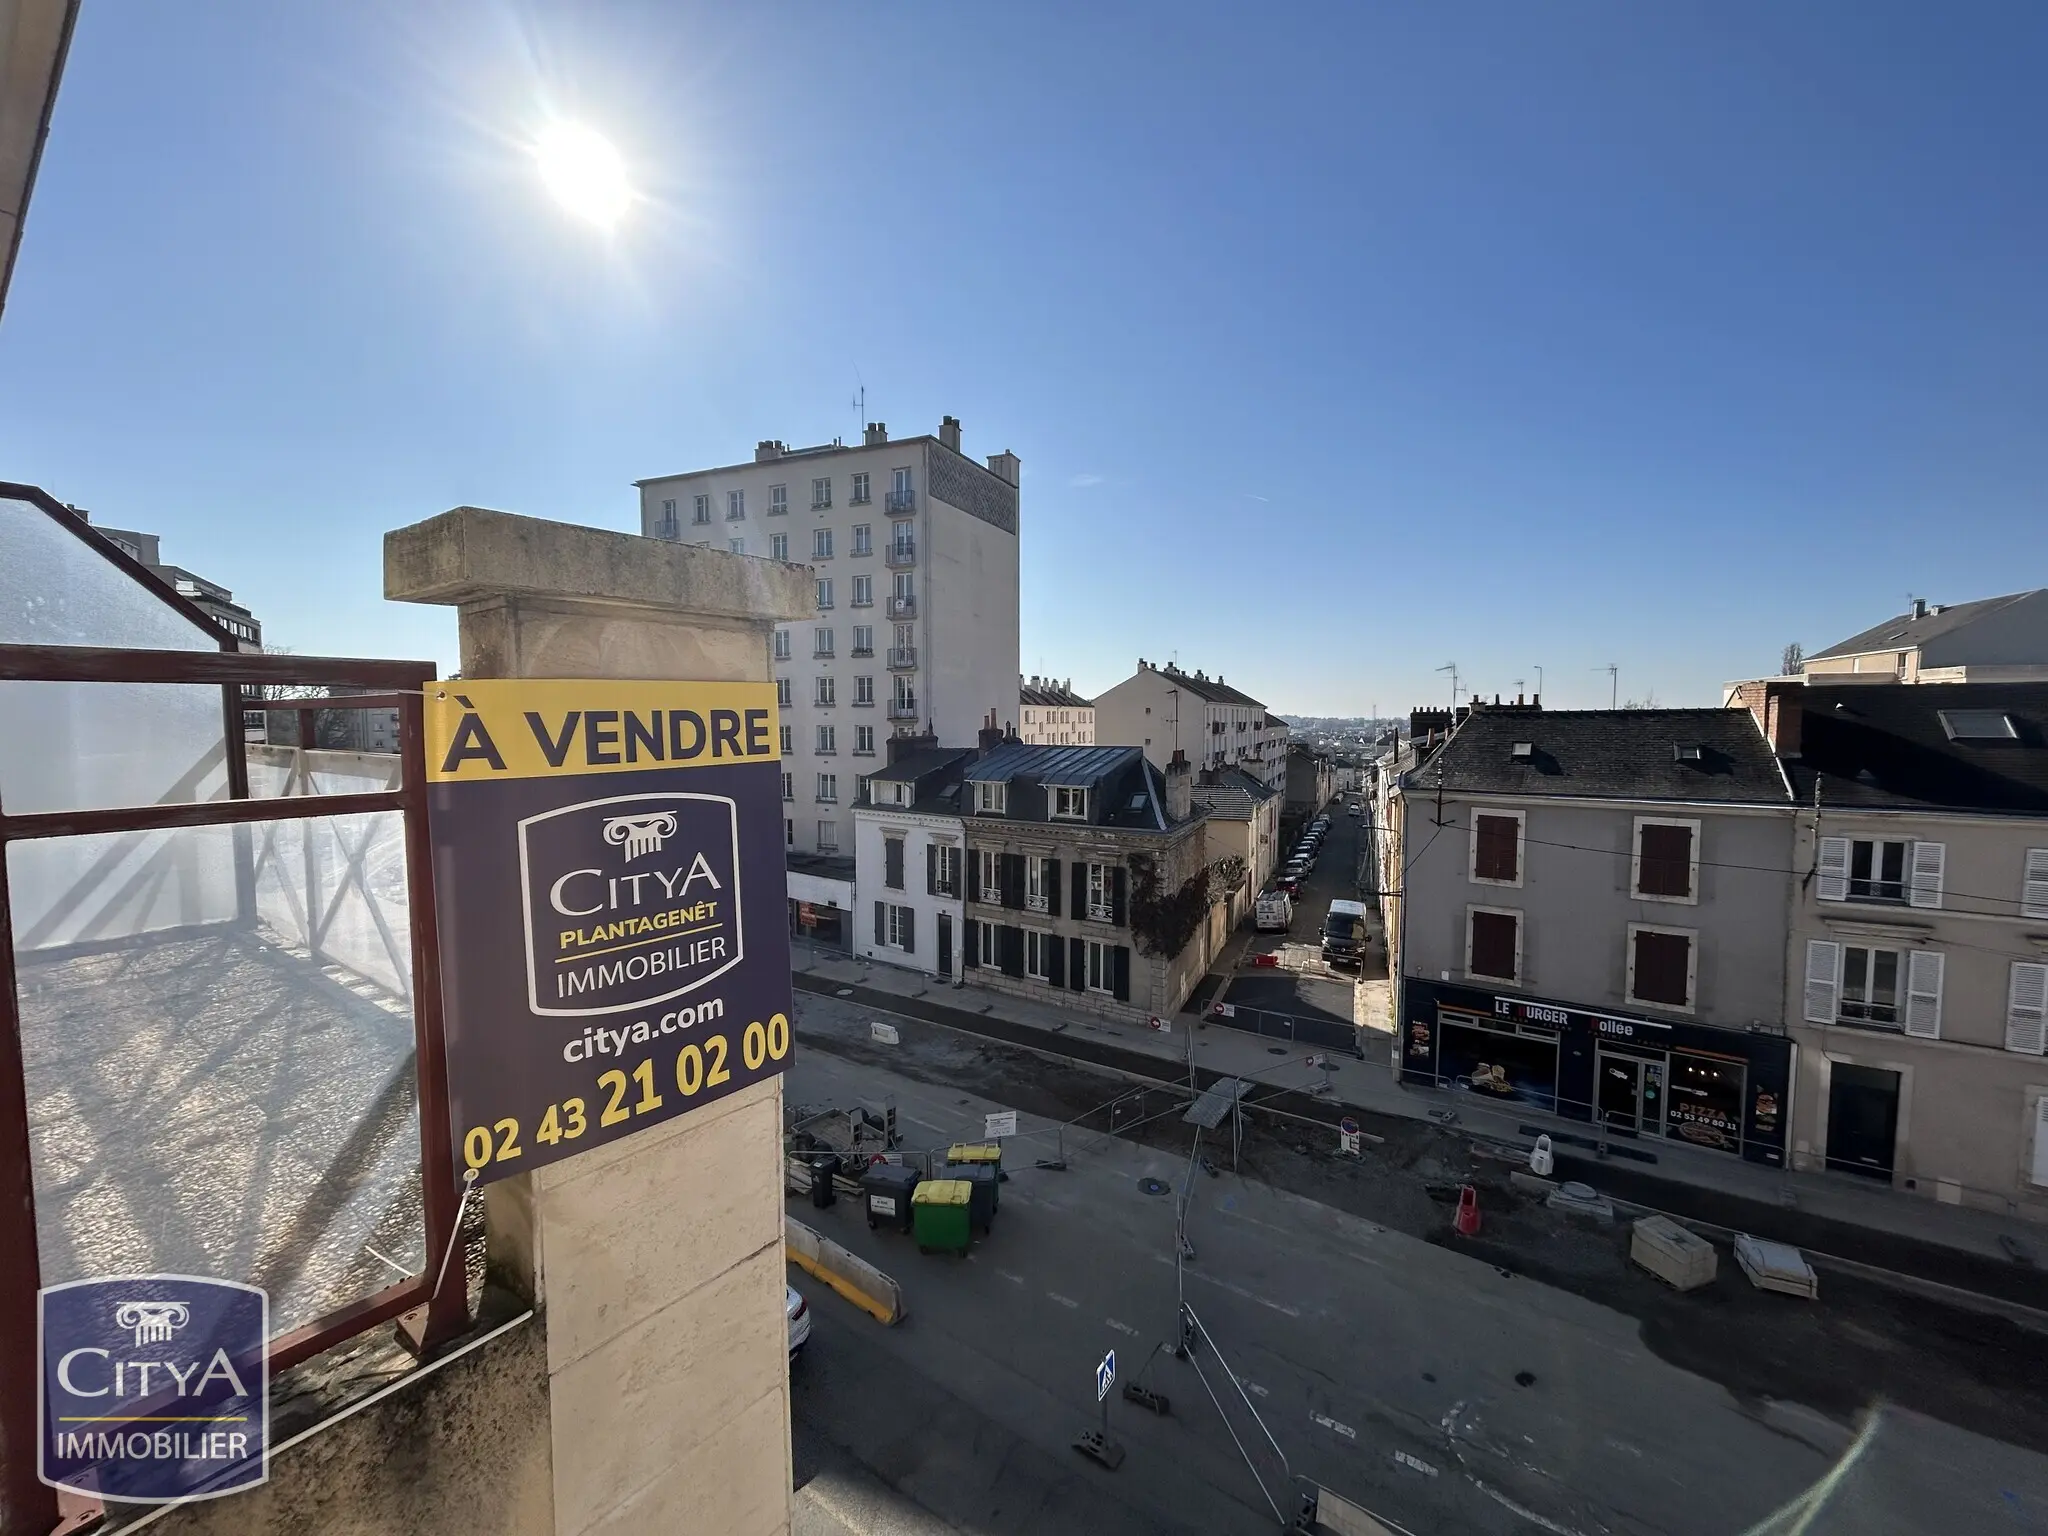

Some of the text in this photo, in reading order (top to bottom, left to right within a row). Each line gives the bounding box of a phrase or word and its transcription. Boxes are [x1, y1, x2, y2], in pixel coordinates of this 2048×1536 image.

[441, 695, 770, 772] À VENDRE
[550, 852, 721, 916] CITYA
[559, 901, 718, 949] PLANTAGENÊT
[557, 937, 726, 998] IMMOBILIER
[563, 997, 724, 1063] citya.com
[1495, 1001, 1510, 1015] LE
[463, 1013, 789, 1169] 02 43 21 02 00
[1670, 1110, 1682, 1119] 02
[1680, 1102, 1728, 1121] PIZZA
